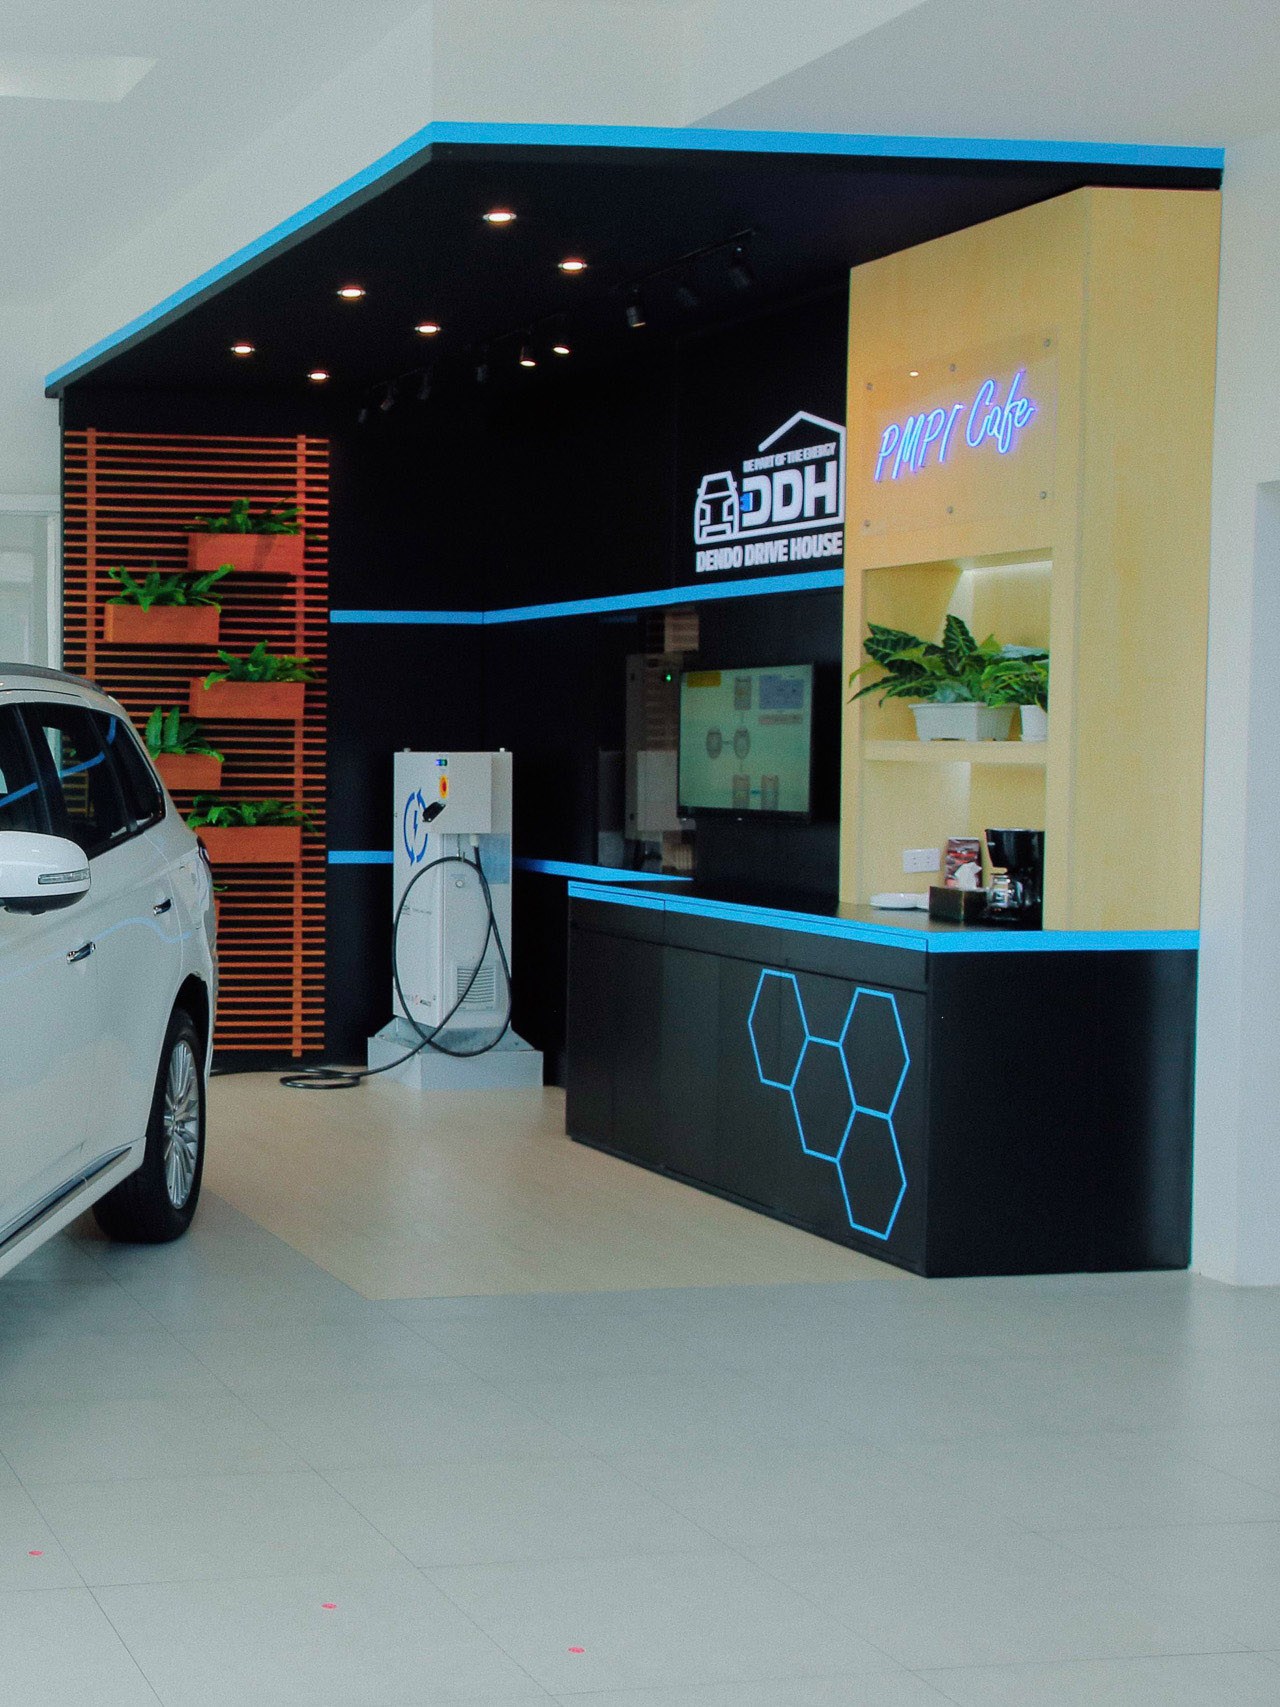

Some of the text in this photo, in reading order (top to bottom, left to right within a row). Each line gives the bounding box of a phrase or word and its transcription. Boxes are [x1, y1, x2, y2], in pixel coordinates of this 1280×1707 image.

[966, 370, 1036, 454] Cafe
[695, 531, 843, 573] DENDO DRIVE HOUSE
